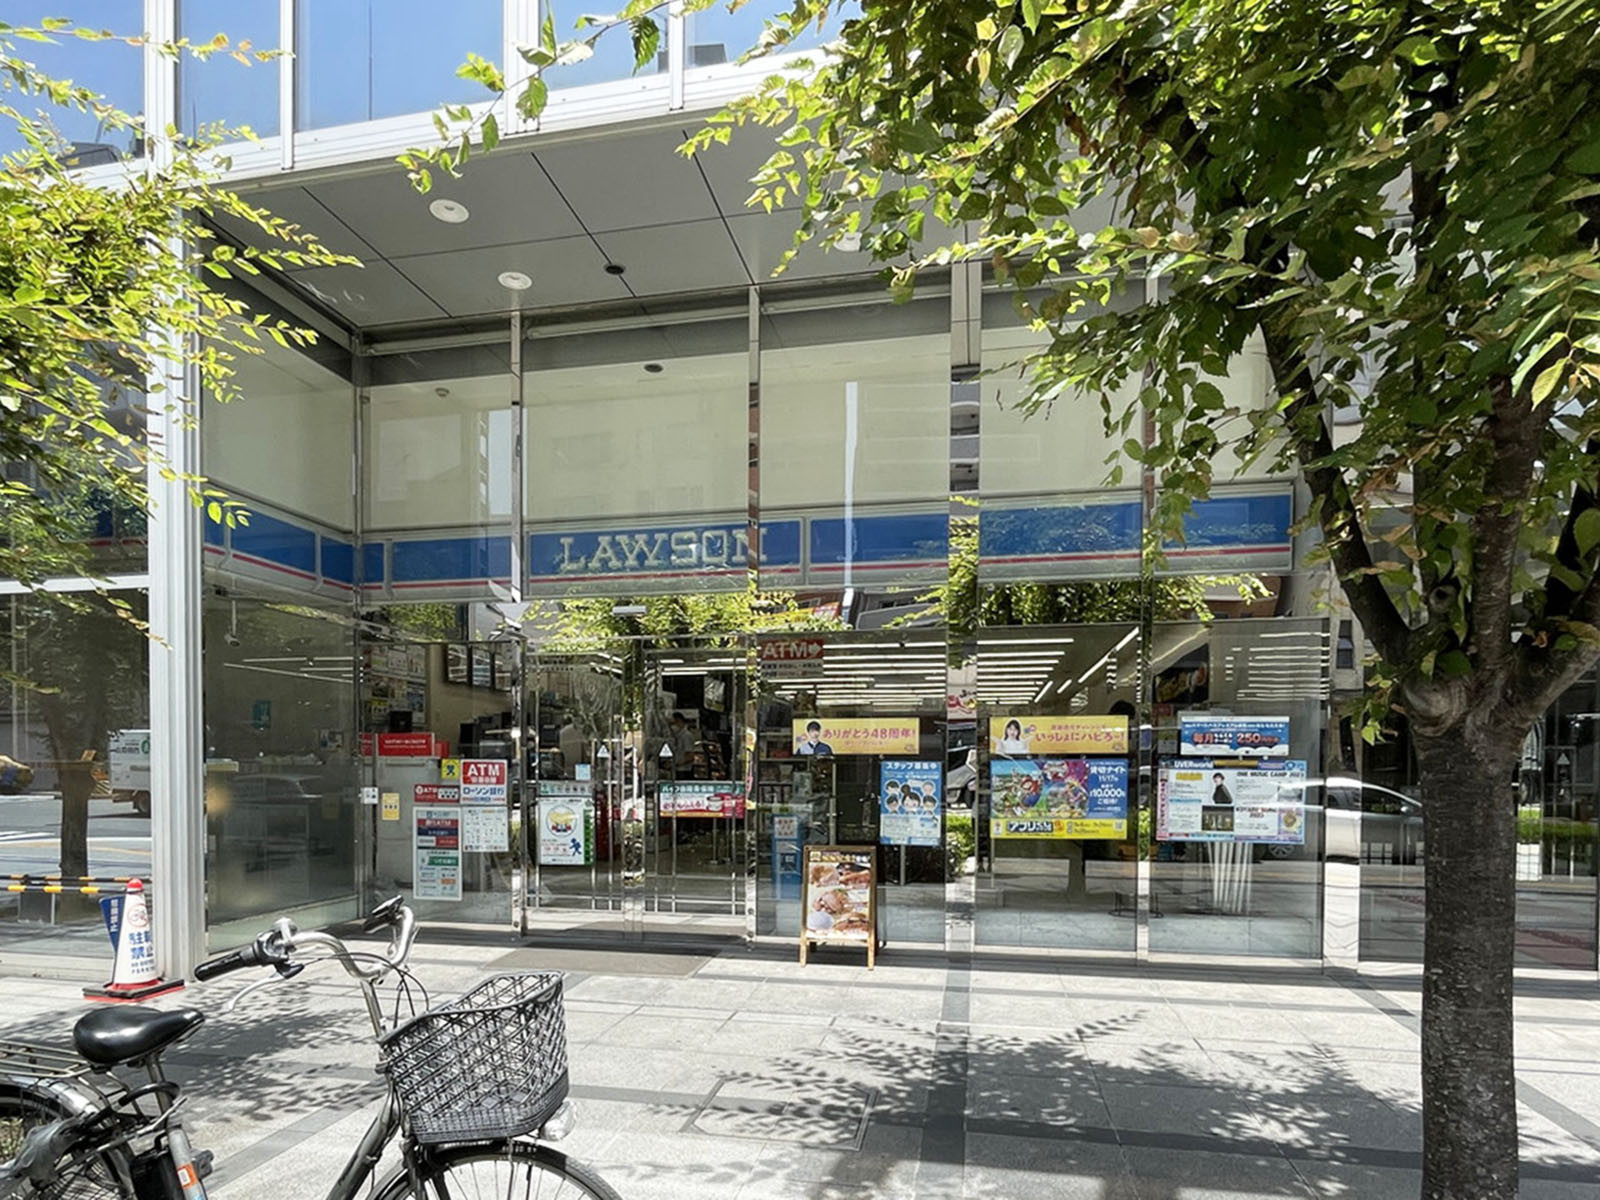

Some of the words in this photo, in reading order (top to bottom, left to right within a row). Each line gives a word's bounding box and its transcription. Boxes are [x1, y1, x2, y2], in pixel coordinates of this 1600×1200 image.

[560, 527, 767, 570] LAWSON
[762, 642, 807, 658] ATM
[467, 764, 500, 776] ATM
[463, 787, 504, 795] ローソン銀行
